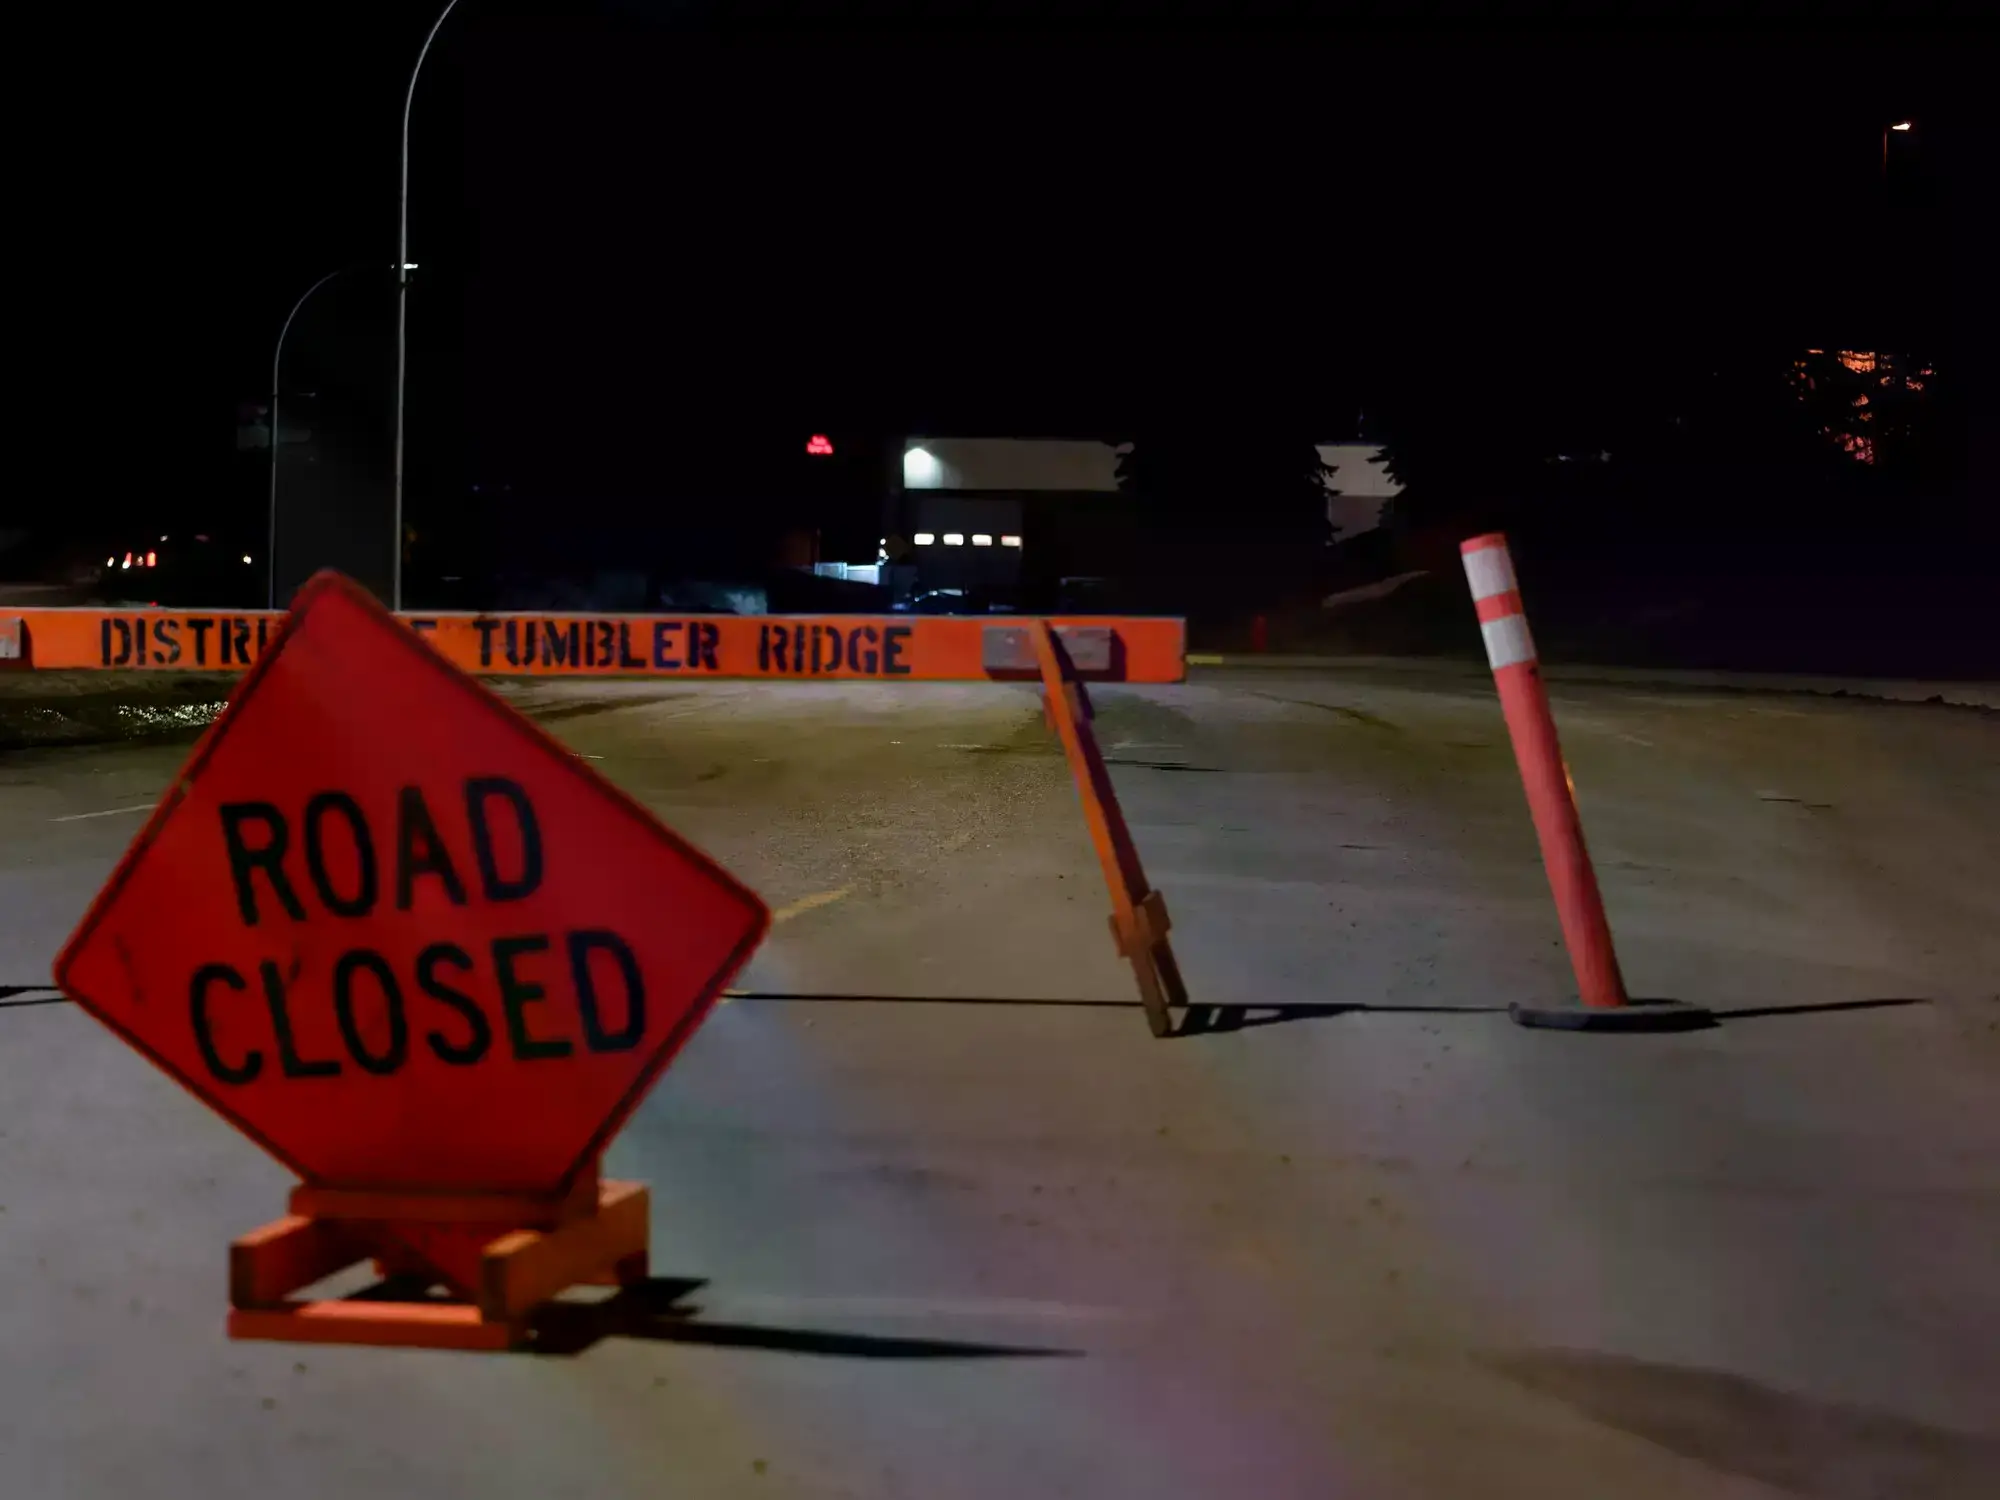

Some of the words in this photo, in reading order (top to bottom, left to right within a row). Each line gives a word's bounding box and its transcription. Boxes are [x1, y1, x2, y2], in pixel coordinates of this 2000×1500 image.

[102, 618, 268, 666] DISTRI
[473, 619, 720, 671] TUMBLER
[758, 624, 913, 674] RIDGE
[220, 776, 544, 926] ROAD
[189, 930, 647, 1085] CLOSED
